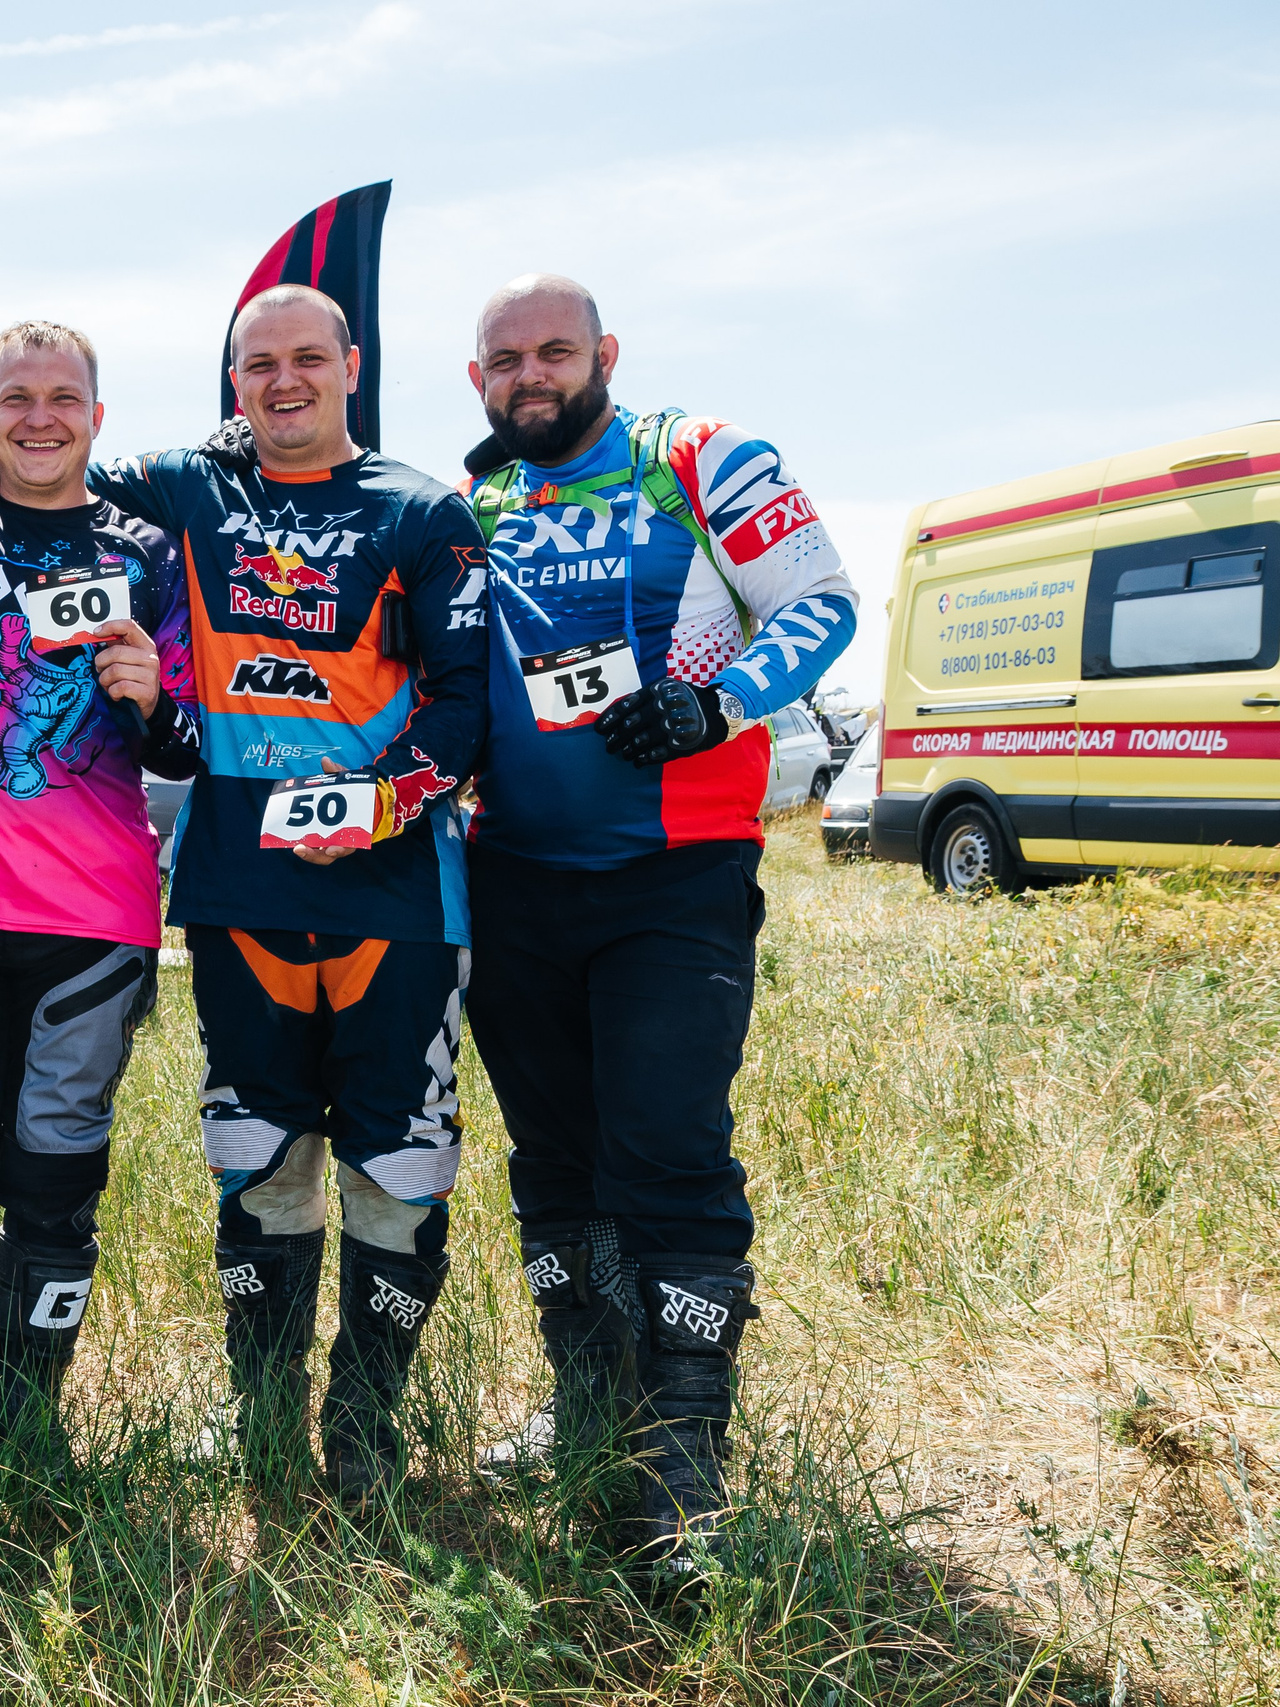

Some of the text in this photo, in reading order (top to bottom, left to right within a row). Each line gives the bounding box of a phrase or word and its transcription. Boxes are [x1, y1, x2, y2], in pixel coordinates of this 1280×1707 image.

[754, 493, 816, 545] FXR
[50, 587, 111, 627] 60
[230, 583, 337, 633] Red Bull
[955, 580, 1075, 610] Стабильный врач
[726, 597, 842, 692] FXR
[939, 610, 1065, 644] +7 (918) 507-03-03
[227, 654, 332, 704] KTM
[941, 646, 1056, 677] 8(800) 101-86-03
[554, 665, 609, 708] 13
[251, 740, 302, 758] WINGS
[912, 730, 1228, 754] СКОРАЯ МЕДИЦИНСКАЯ ПОМОЩЬ
[257, 756, 285, 768] LIFE
[286, 792, 347, 827] 50
[29, 1278, 92, 1329] G
